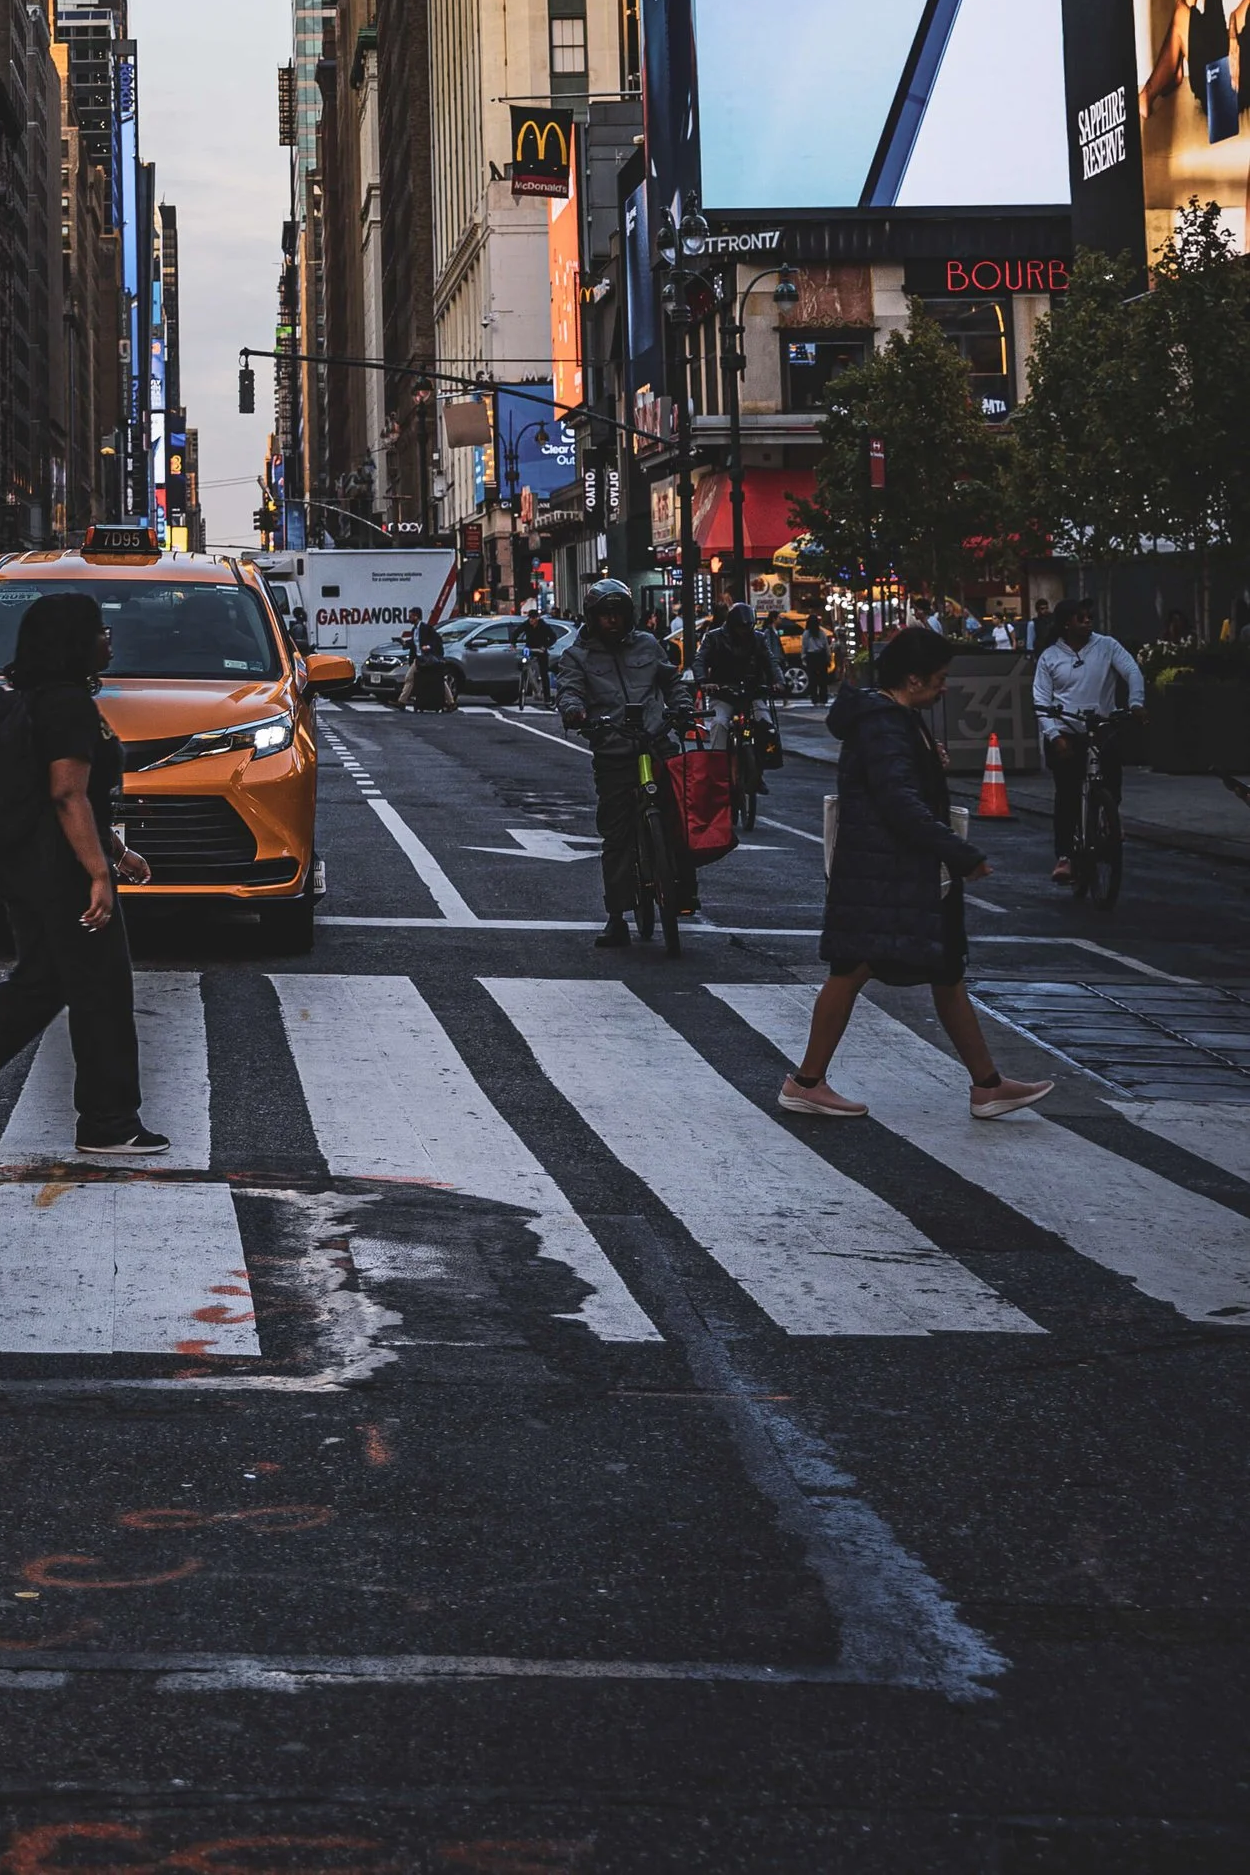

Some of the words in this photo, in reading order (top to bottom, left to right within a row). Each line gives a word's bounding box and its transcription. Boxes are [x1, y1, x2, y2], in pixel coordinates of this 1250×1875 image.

[1078, 86, 1126, 145] SAPPHIRE
[1082, 125, 1126, 180] RESERVE
[514, 180, 567, 194] McDonald's
[541, 444, 569, 454] Clear
[103, 532, 140, 547] 7D95
